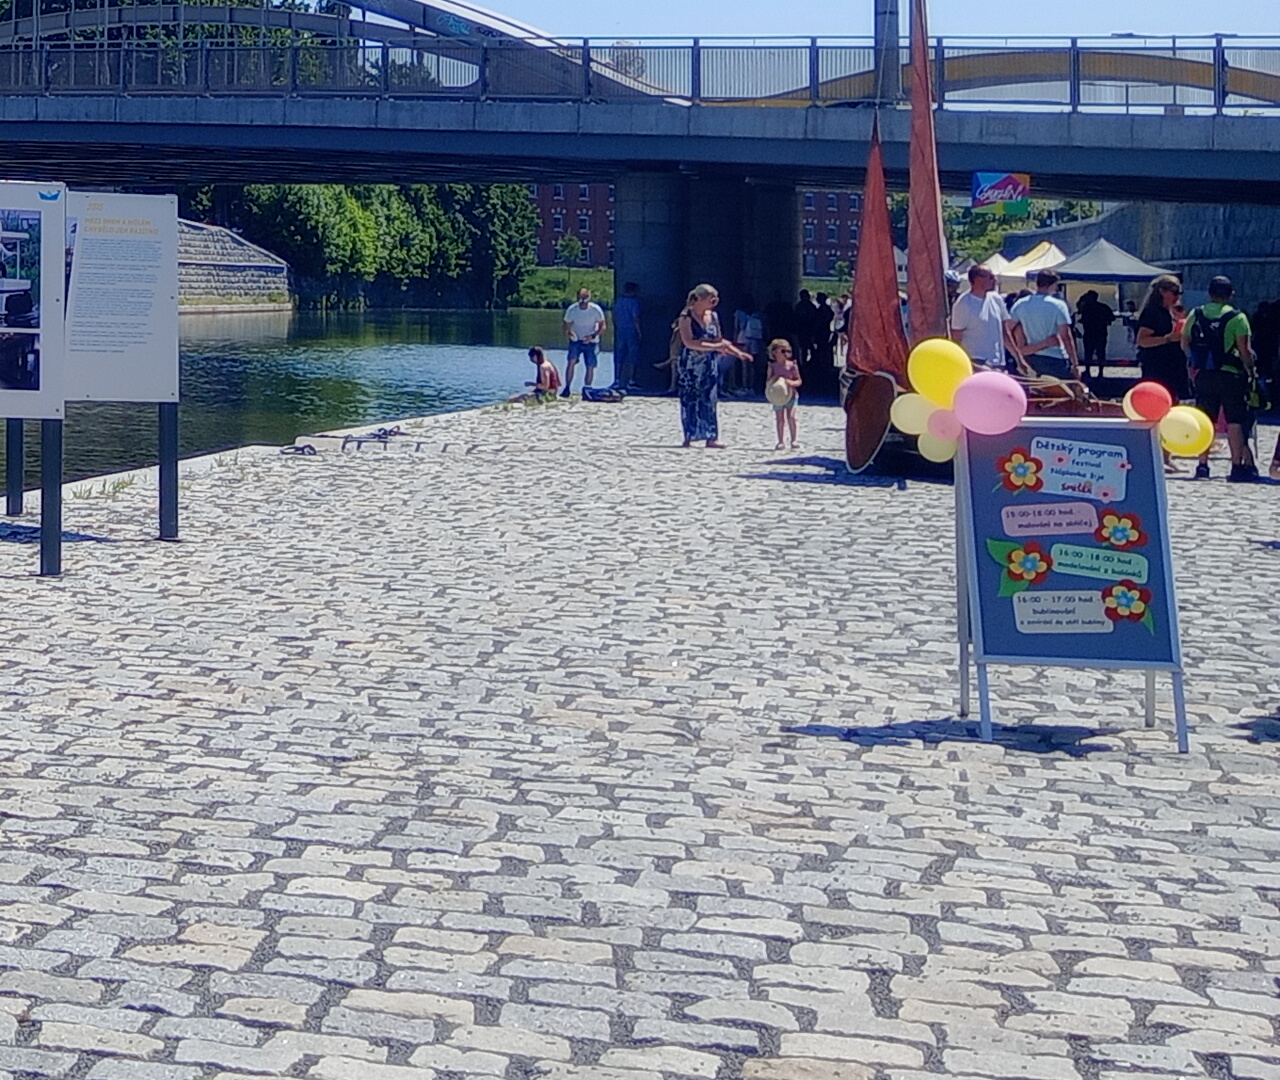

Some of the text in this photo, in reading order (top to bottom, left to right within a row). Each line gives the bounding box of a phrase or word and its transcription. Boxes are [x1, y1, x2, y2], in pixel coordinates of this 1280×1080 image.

[1035, 440, 1123, 459] Dětský program
[1071, 458, 1102, 468] festival
